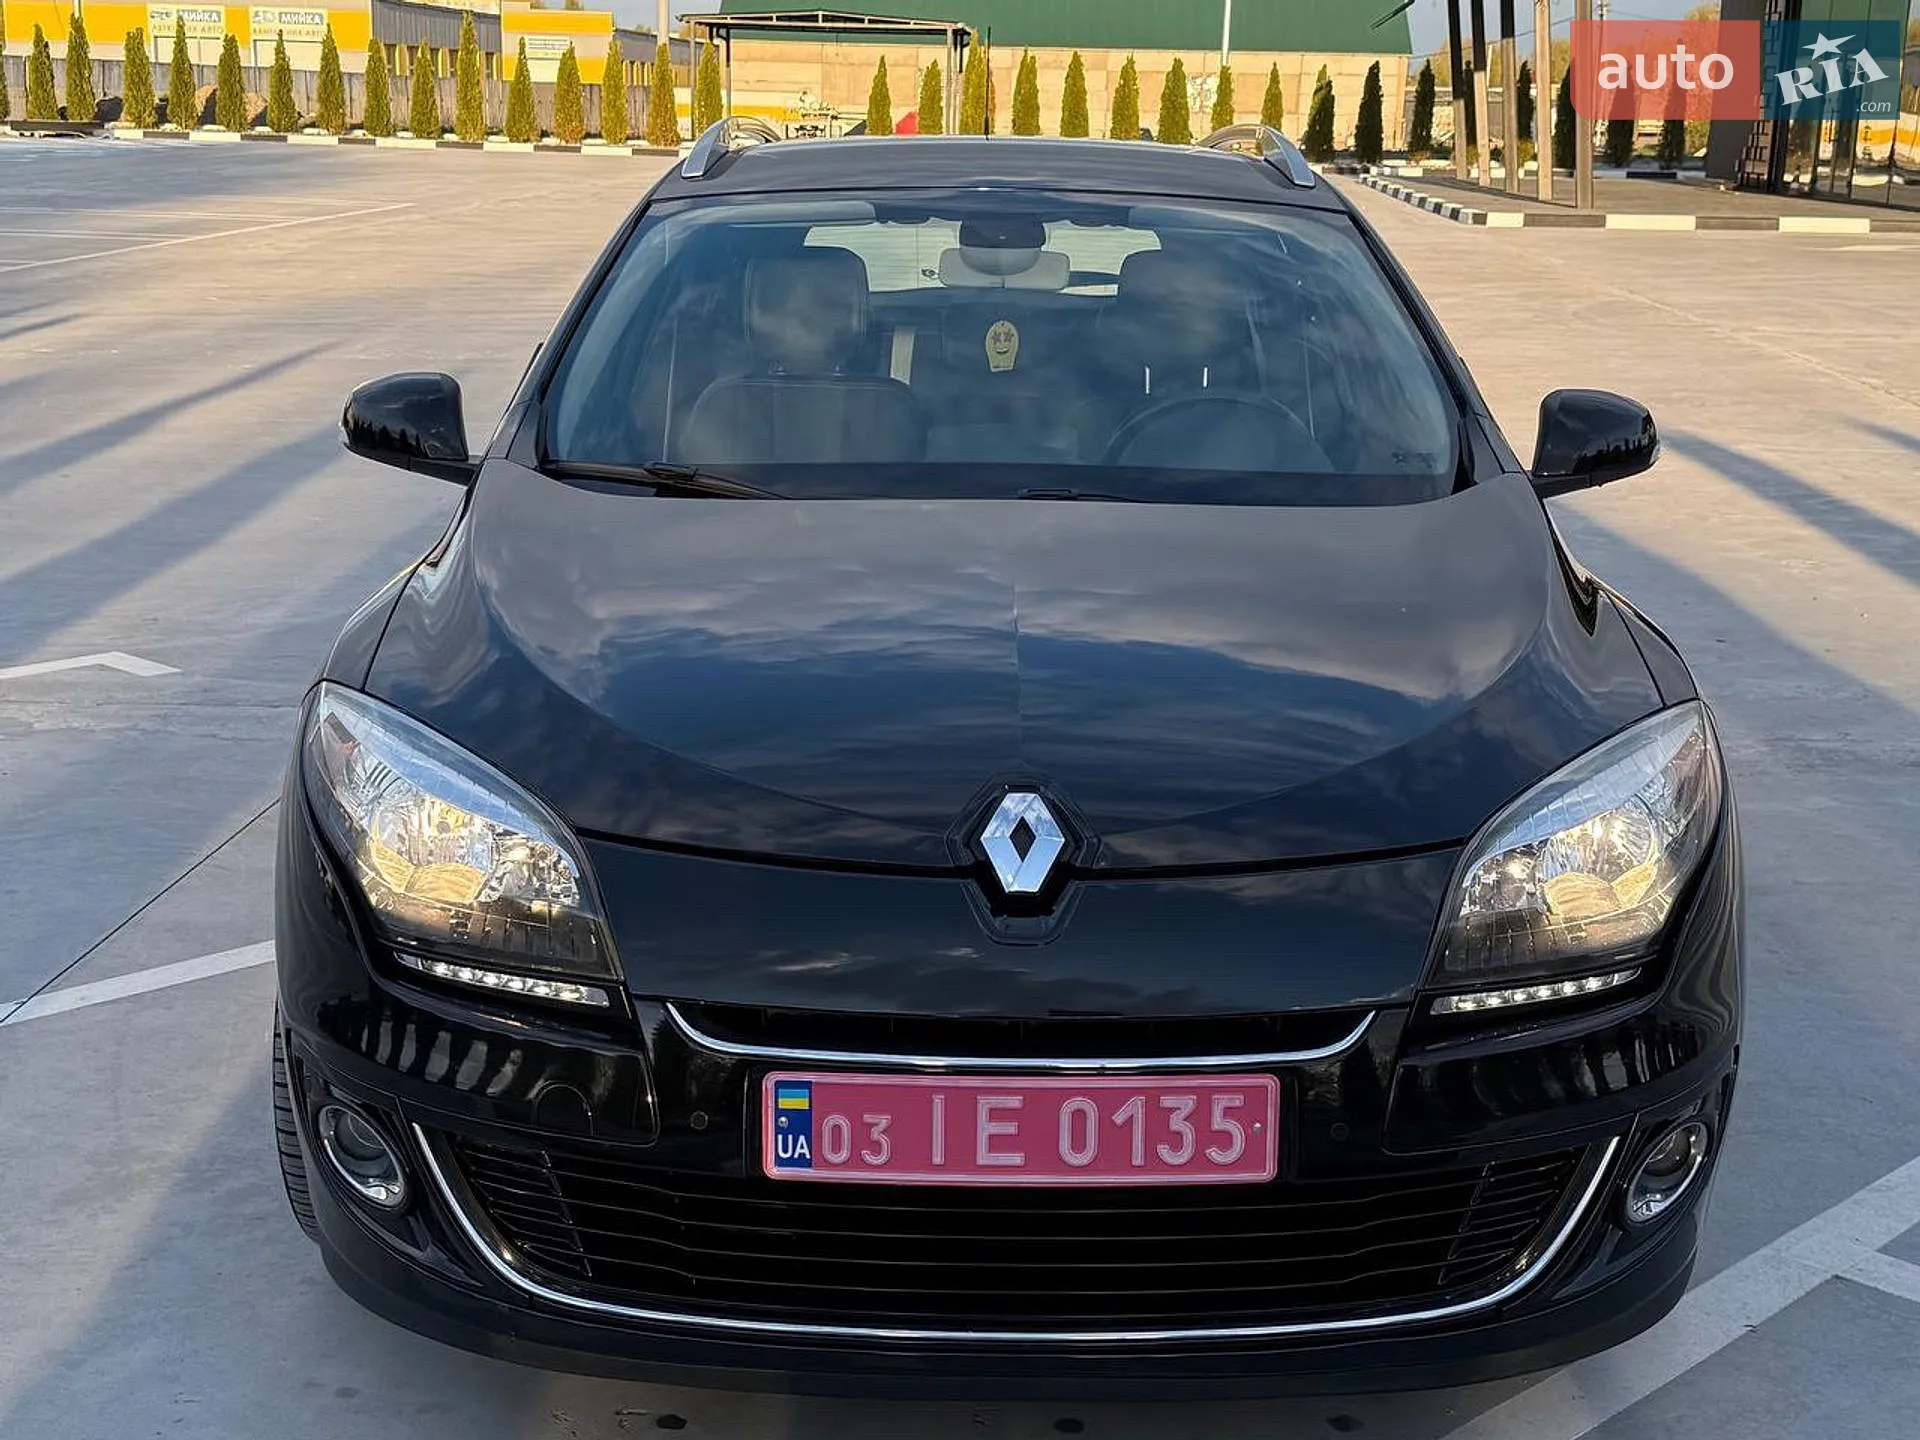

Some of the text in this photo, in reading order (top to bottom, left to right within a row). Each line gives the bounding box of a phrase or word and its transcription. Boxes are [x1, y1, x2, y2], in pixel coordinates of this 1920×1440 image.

[777, 1134, 811, 1159] UA
[821, 1114, 892, 1166] 03
[1058, 1095, 1246, 1167] 0135
